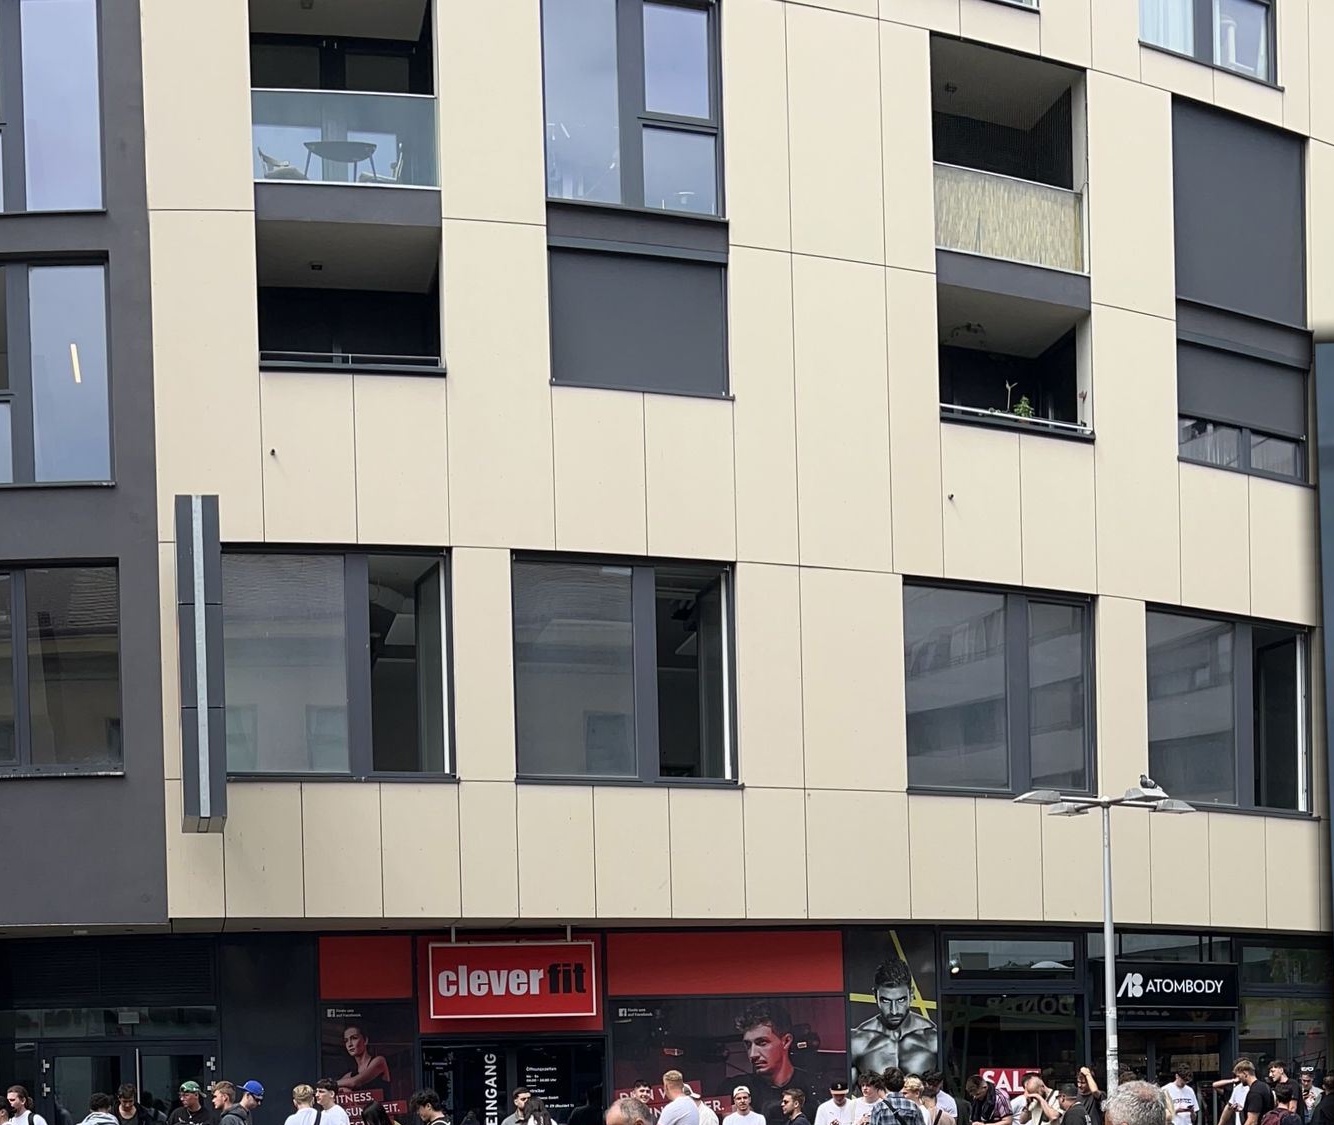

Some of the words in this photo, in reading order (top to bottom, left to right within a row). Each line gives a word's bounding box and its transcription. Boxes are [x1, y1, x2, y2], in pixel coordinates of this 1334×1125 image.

[438, 965, 544, 997] clever
[547, 962, 587, 994] fit
[1145, 978, 1224, 993] ATOMBODY
[484, 1053, 498, 1125] EINGANG
[983, 1071, 1039, 1092] SAL
[335, 1092, 375, 1103] ITNESS.
